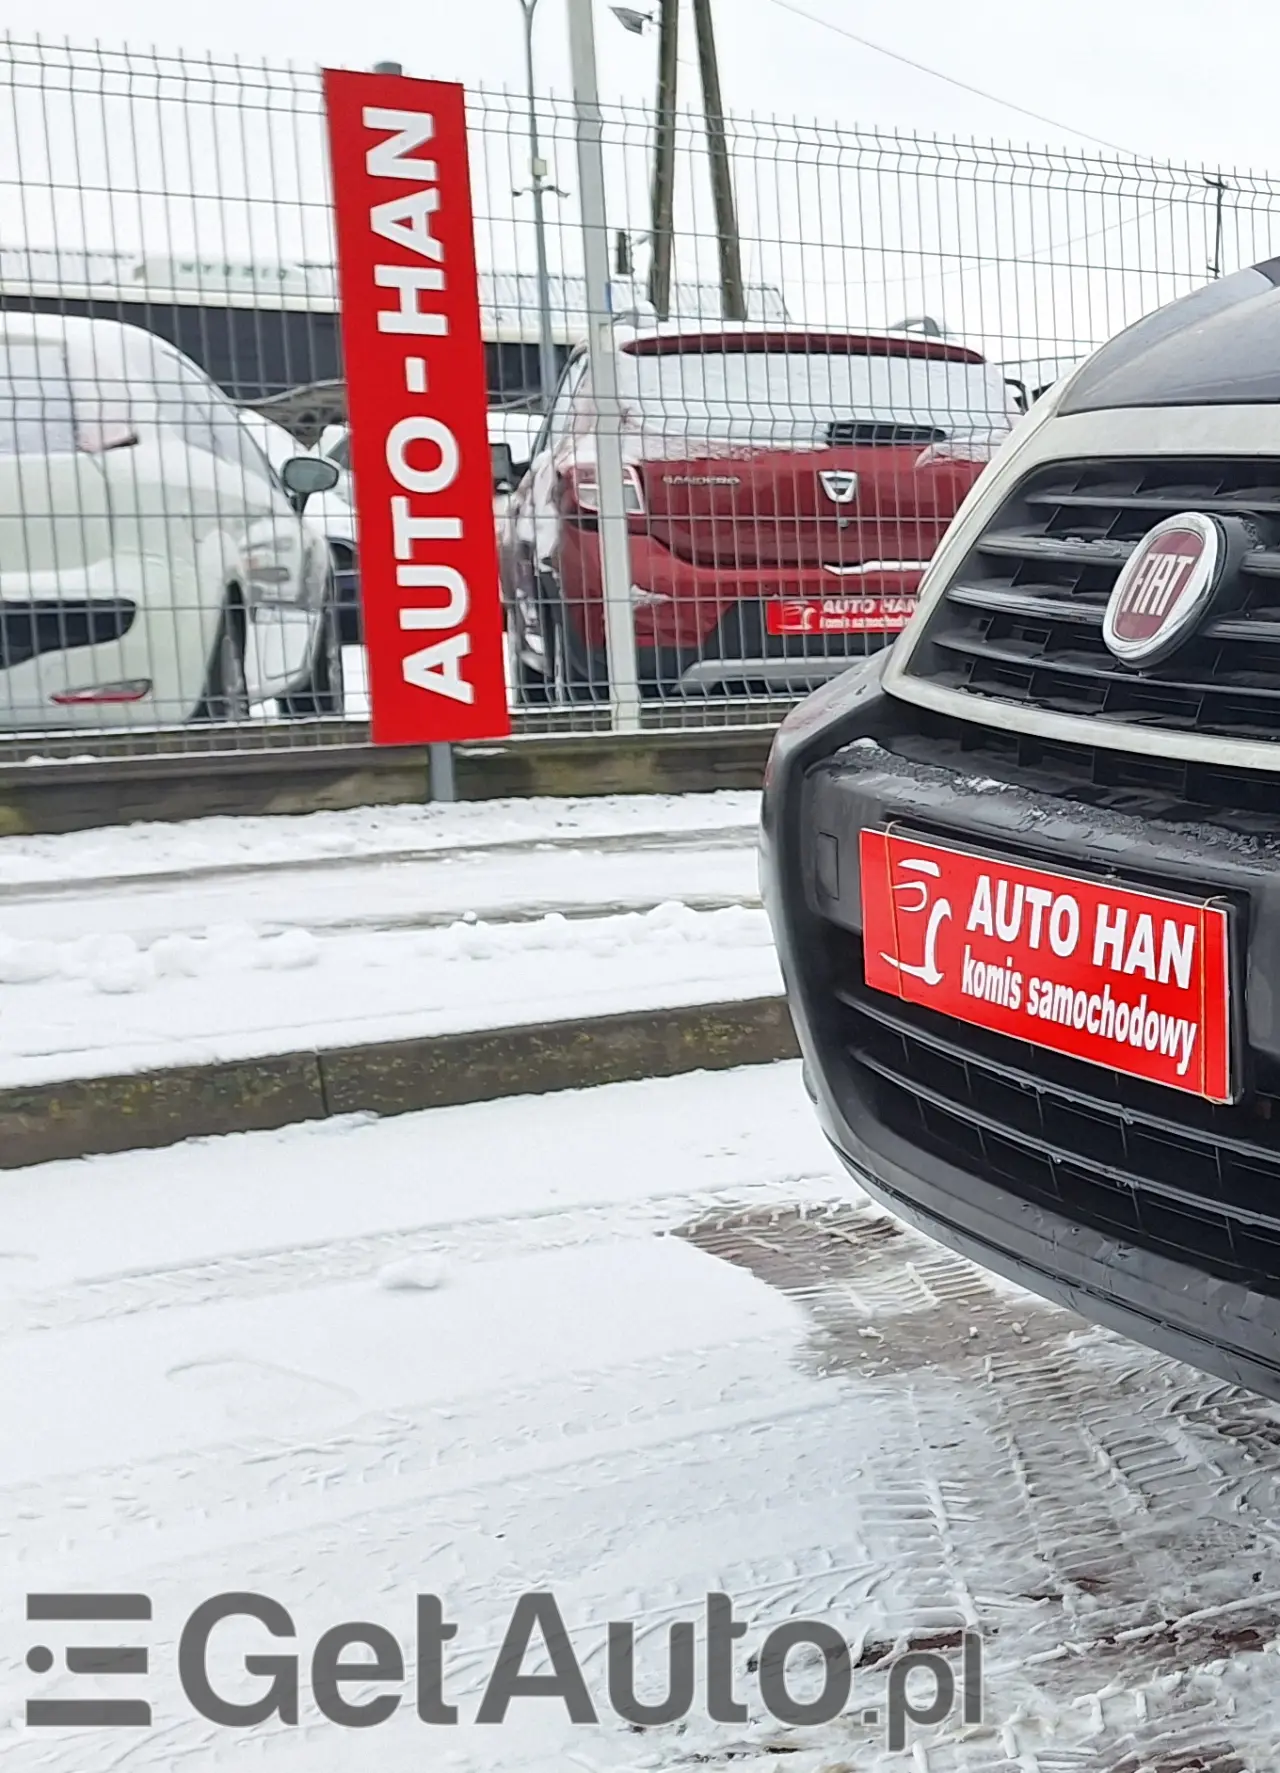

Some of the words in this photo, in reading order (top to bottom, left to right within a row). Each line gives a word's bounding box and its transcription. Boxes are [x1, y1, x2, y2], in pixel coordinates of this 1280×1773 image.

[362, 105, 450, 337] HAN
[384, 415, 475, 704] AUTO
[822, 600, 876, 614] AUTO
[1121, 552, 1195, 617] FIAT
[966, 875, 1080, 957] AUTO
[1092, 903, 1196, 990] HAN
[961, 945, 1022, 1011] komis
[1026, 976, 1198, 1076] samochodowy
